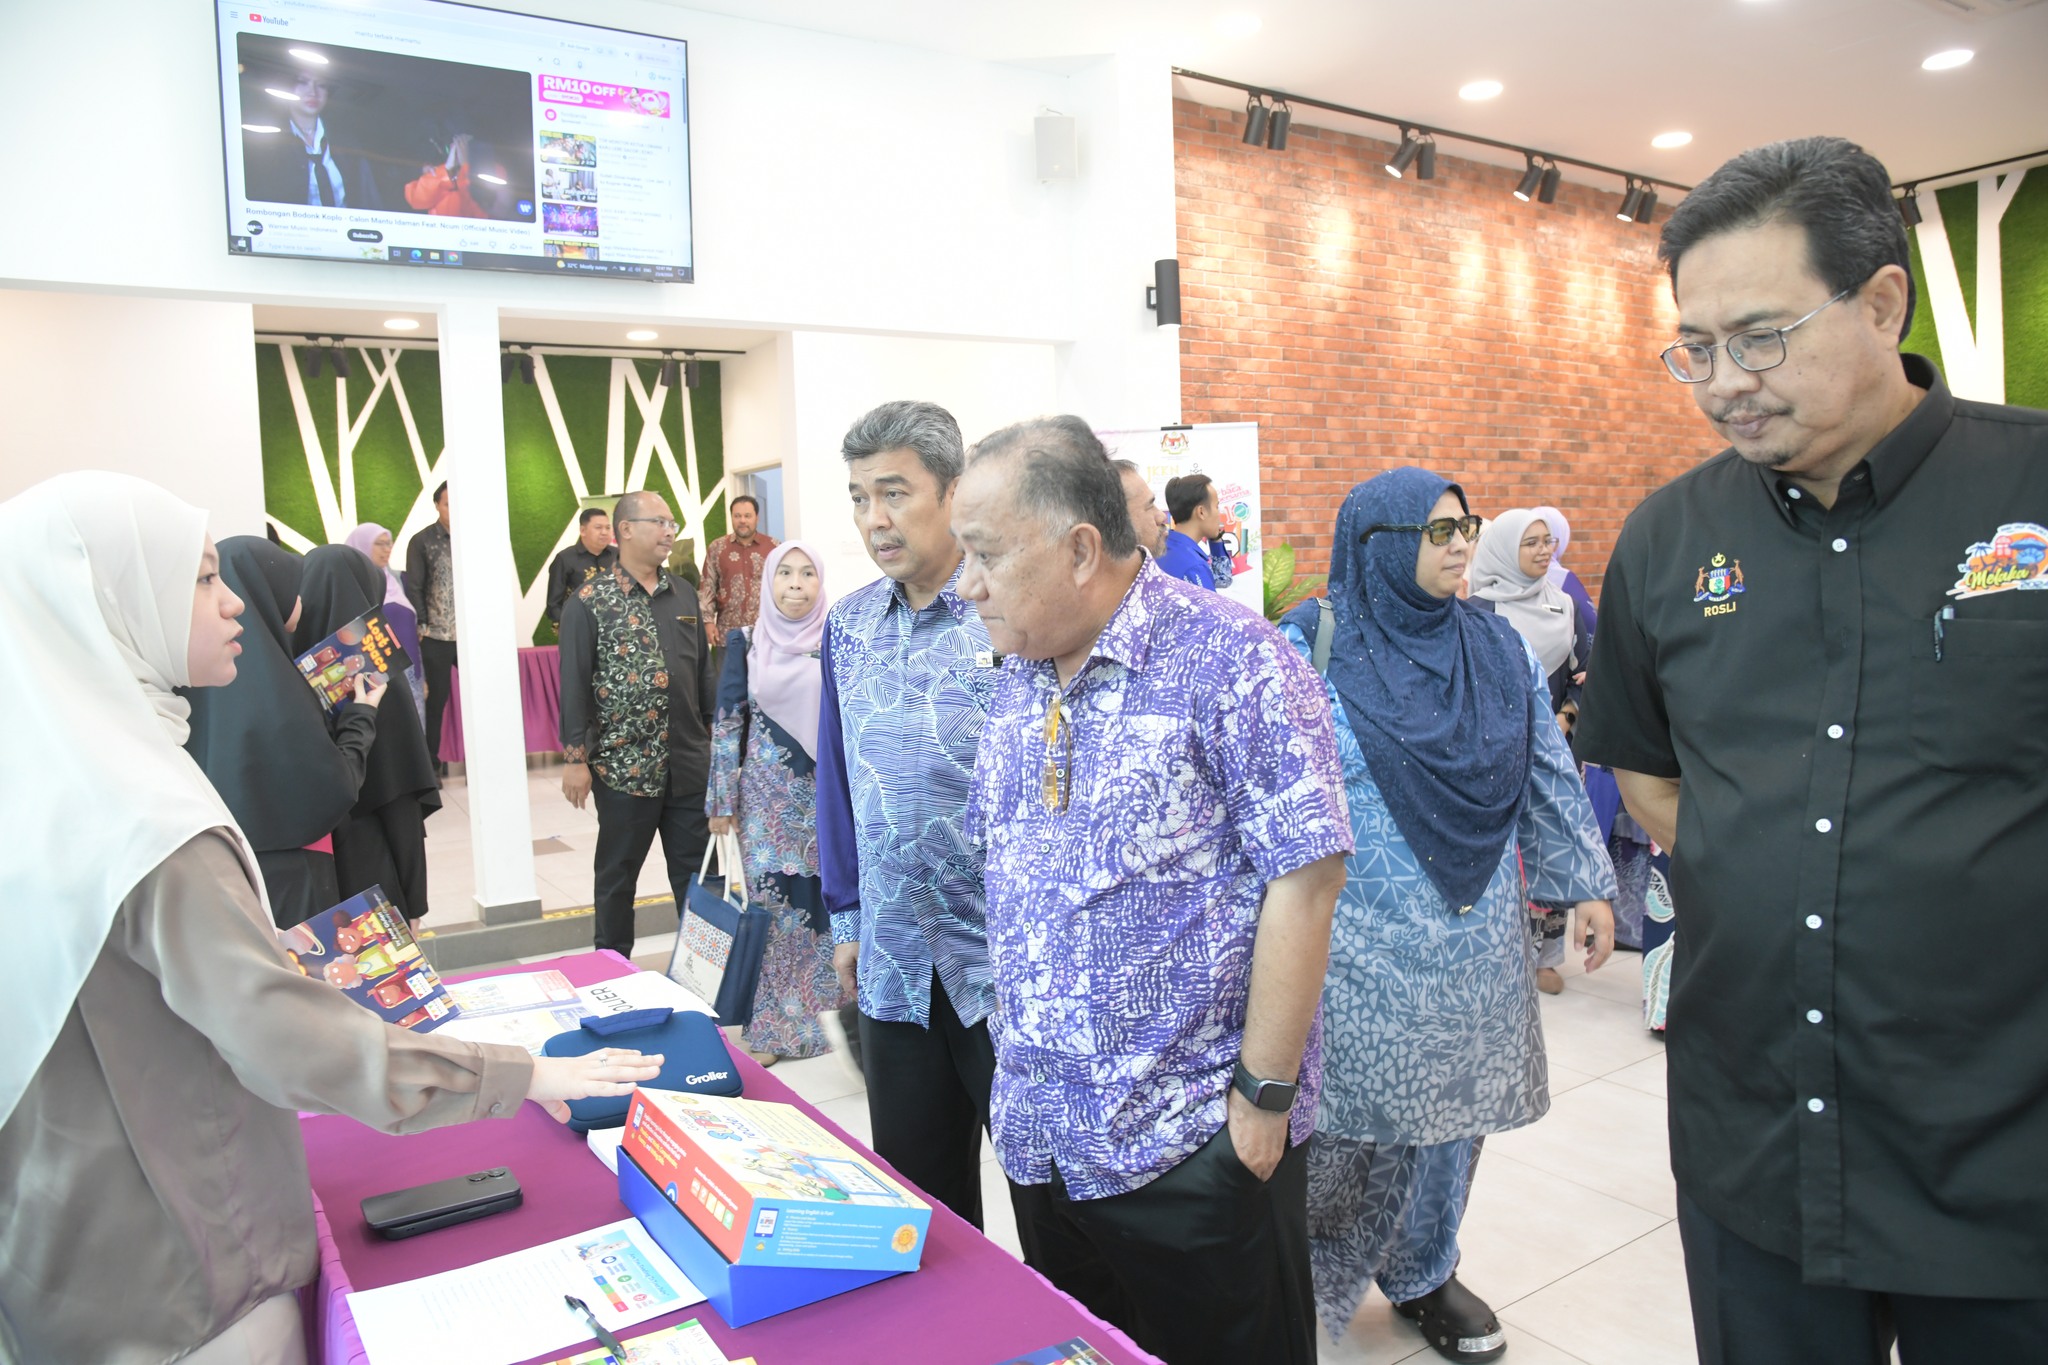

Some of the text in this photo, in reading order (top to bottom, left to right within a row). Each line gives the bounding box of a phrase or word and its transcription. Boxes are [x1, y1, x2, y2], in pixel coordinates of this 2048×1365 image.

[262, 15, 289, 26] YouTube
[543, 76, 617, 97] RM10 OFF
[245, 207, 291, 218] Rombongan
[292, 210, 320, 219] Bodonk
[321, 213, 342, 222] Koplo
[349, 215, 369, 223] Calon
[371, 217, 393, 225] Mantu
[394, 219, 420, 227] Idaman
[461, 223, 487, 232] (Official
[489, 226, 508, 234] Music
[509, 227, 531, 236] Video)
[579, 263, 594, 271] Mostly
[1221, 486, 1242, 496] baca
[1965, 565, 2029, 590] Melaka
[1704, 601, 1737, 617] ROSLI
[366, 617, 389, 648] Lost
[362, 634, 388, 673] Space
[590, 986, 633, 1012] OLIER
